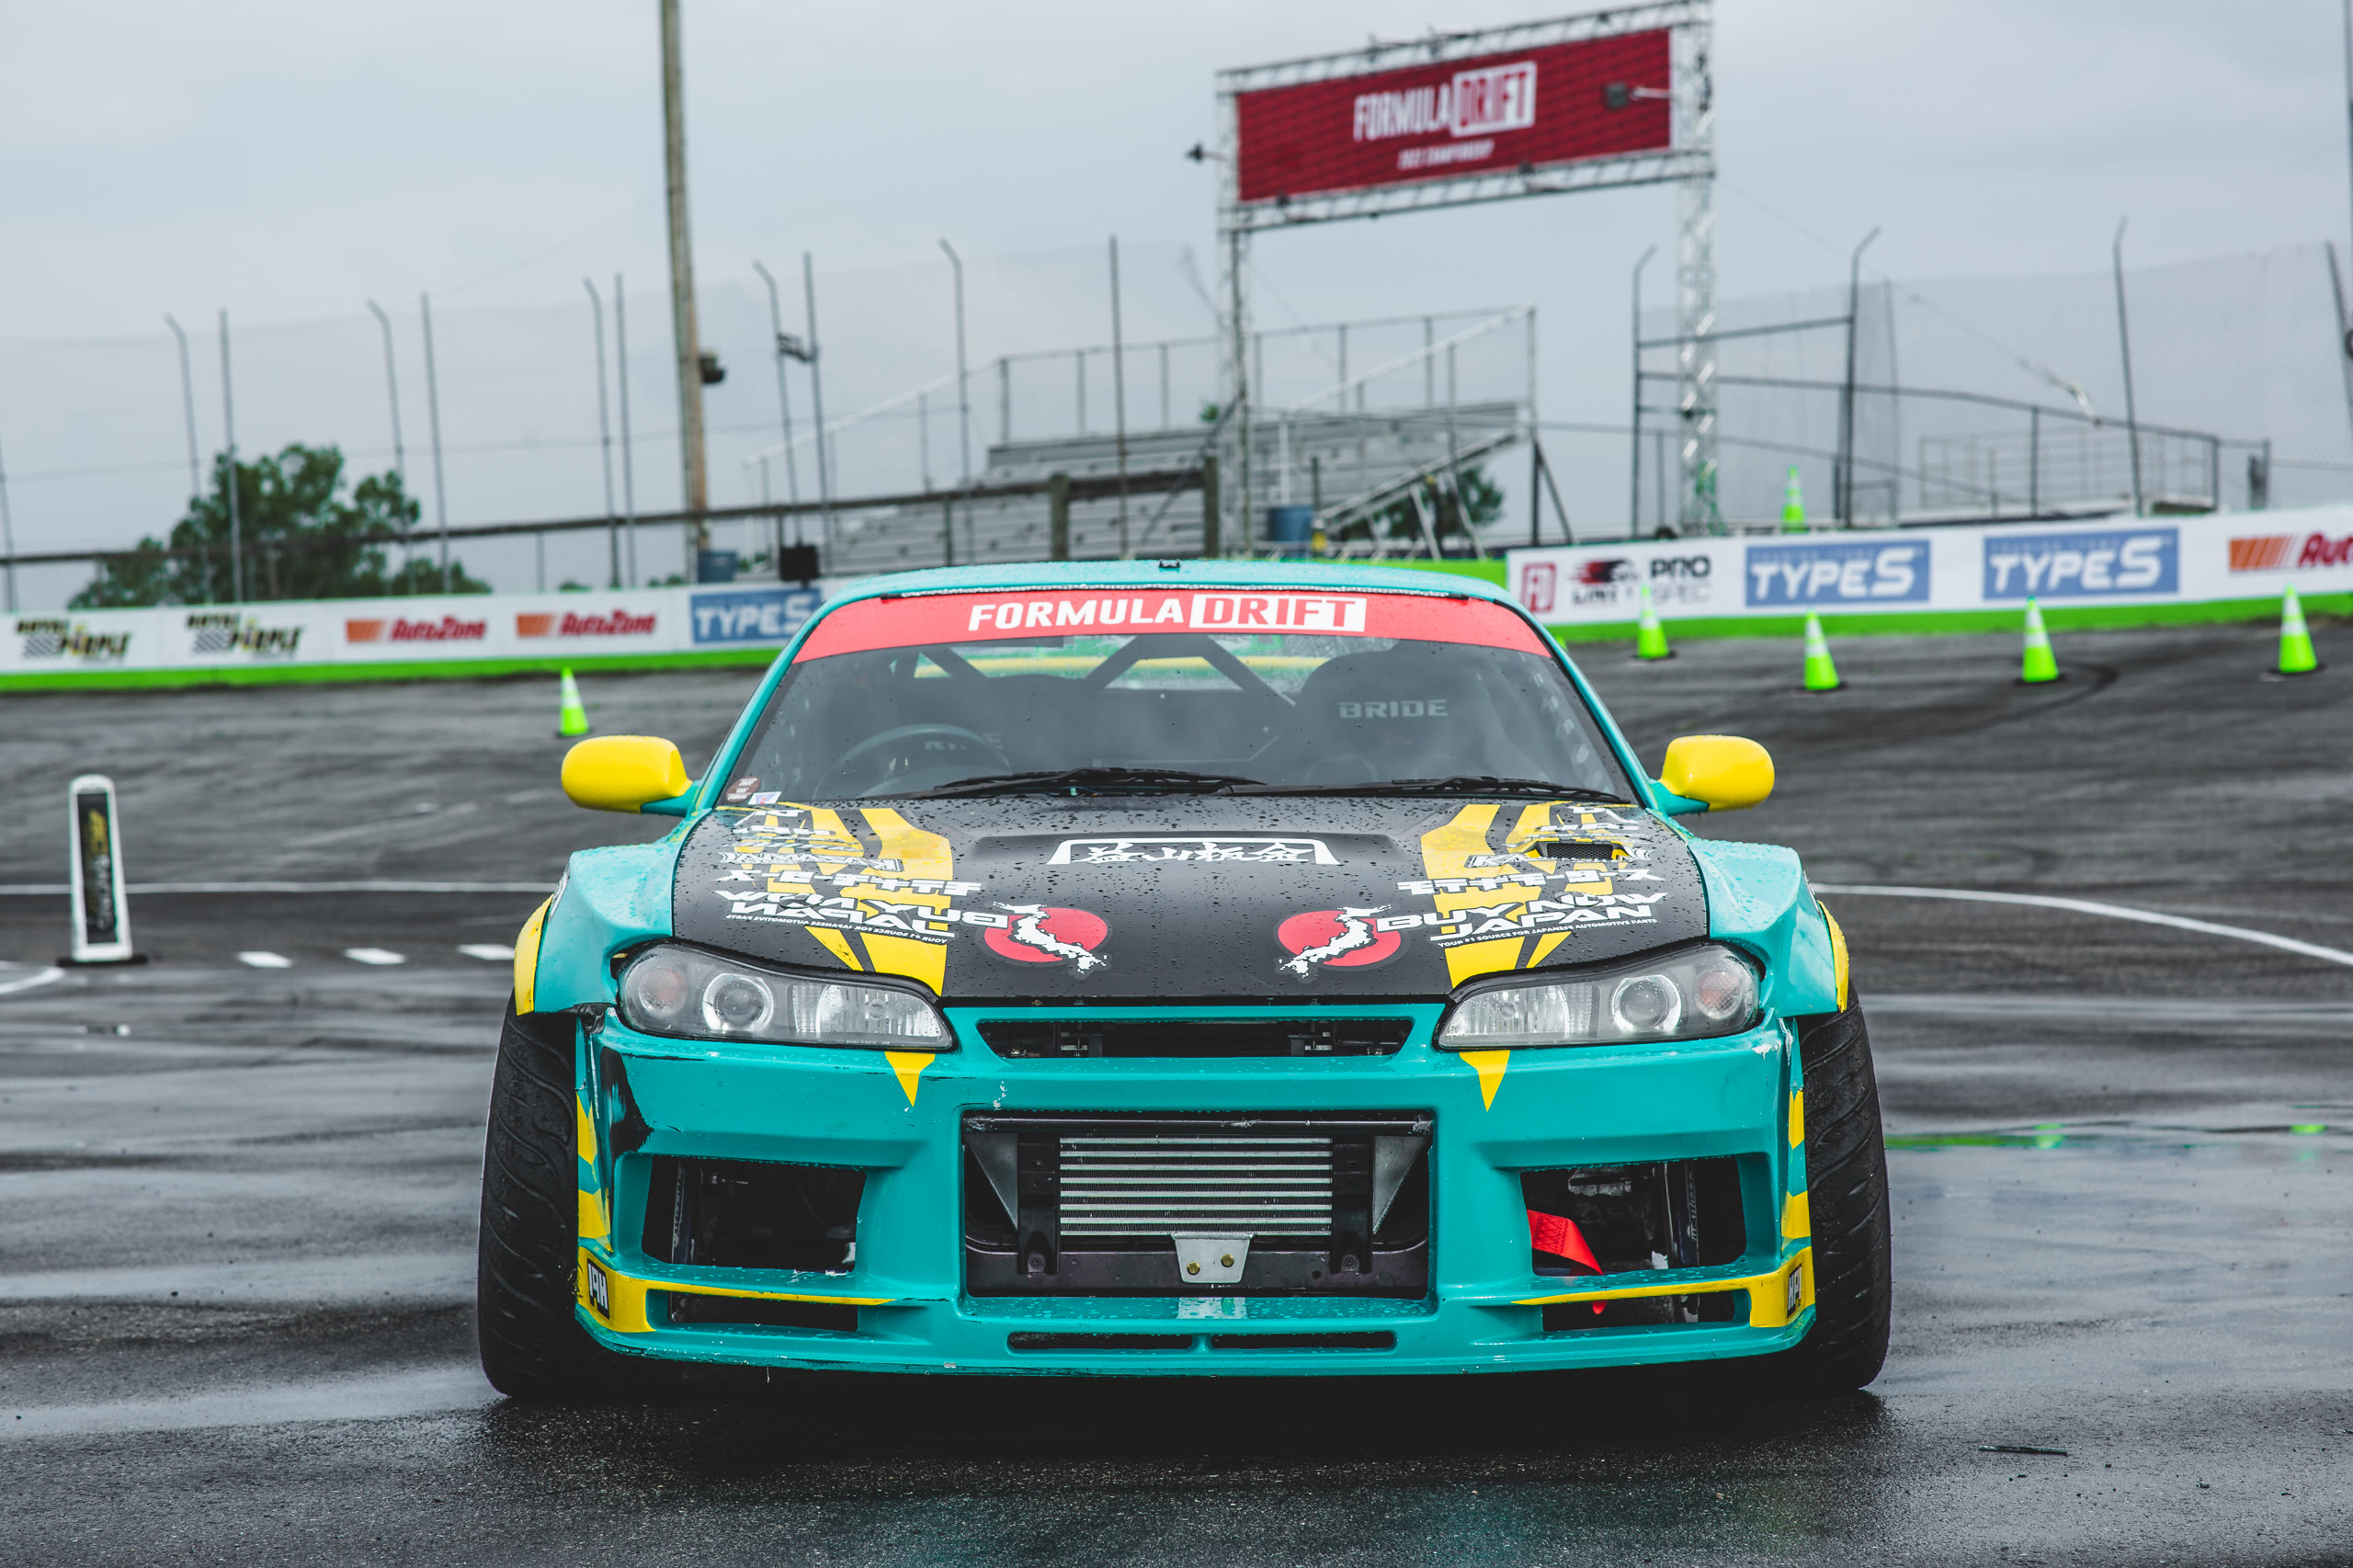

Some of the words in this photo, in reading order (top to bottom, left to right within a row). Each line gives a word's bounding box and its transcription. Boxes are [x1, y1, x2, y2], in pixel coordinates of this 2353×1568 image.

[1353, 83, 1450, 142] FORMULA
[1454, 65, 1532, 132] DRIFT
[968, 597, 1185, 631] FORMULA
[1200, 596, 1358, 629] DRIFT
[1337, 699, 1449, 719] BRIDE
[1376, 902, 1518, 932] BUY
[1528, 892, 1669, 913] NOW
[1429, 903, 1654, 941] JAPAN
[1438, 939, 1463, 948] YOUR
[1475, 931, 1510, 941] SOURCE
[1531, 925, 1574, 934] JAPANESE
[1575, 920, 1630, 929] AUTOMOTIVE
[1631, 918, 1657, 926] PARTS
